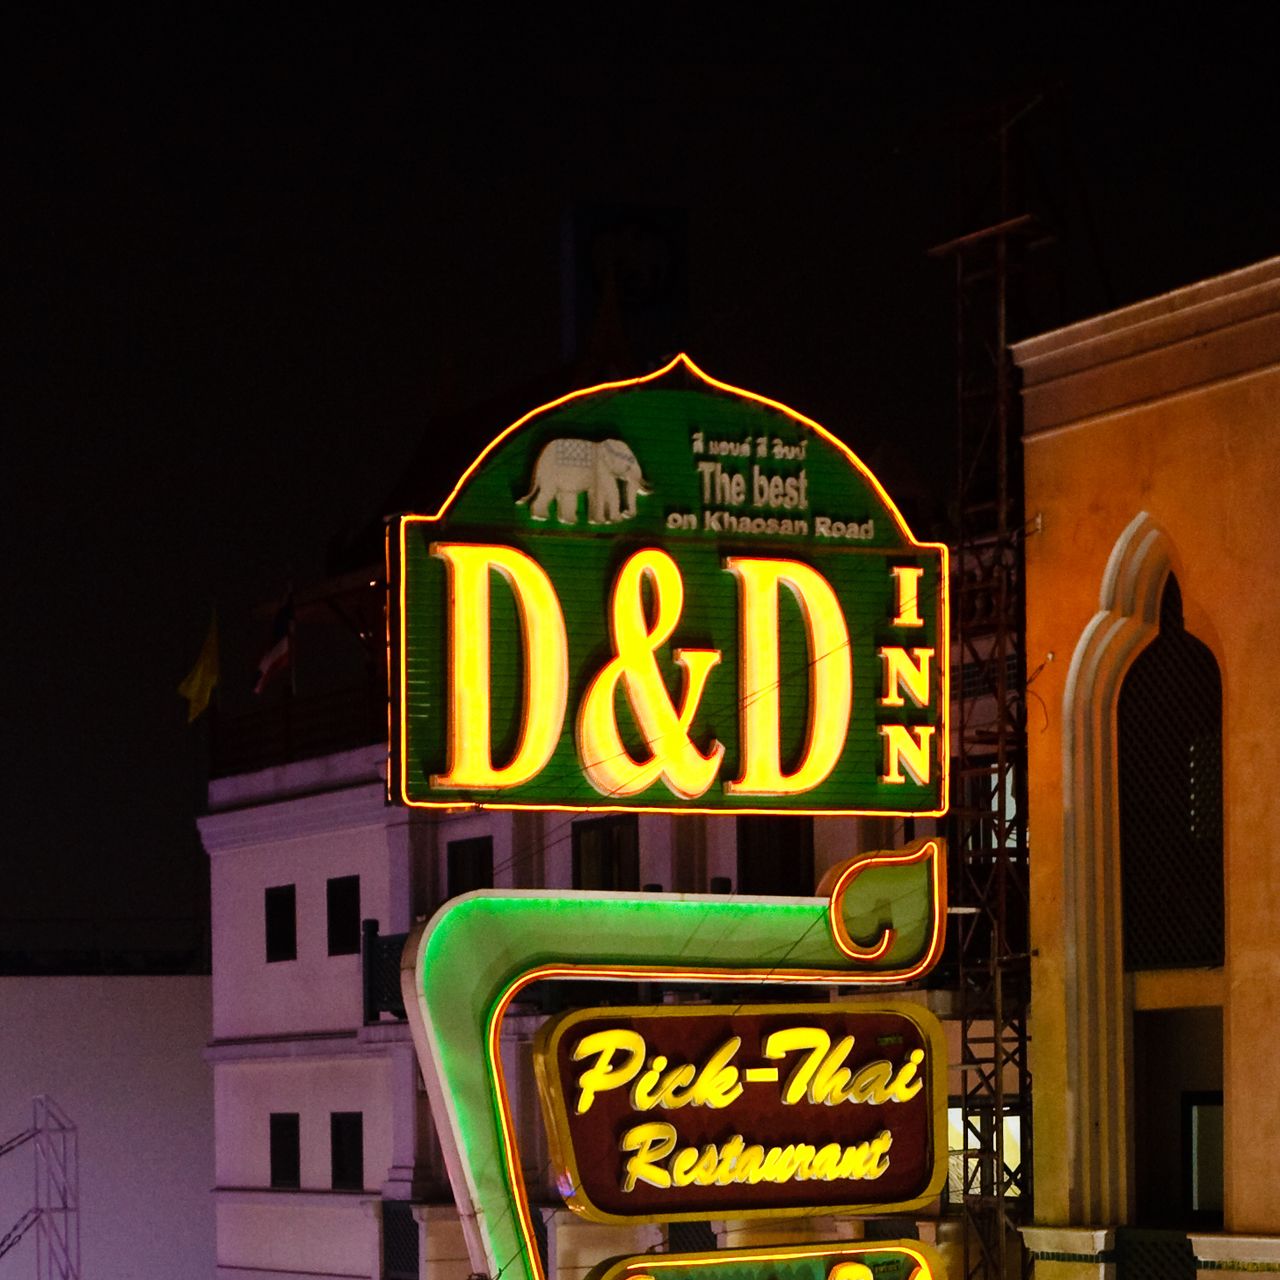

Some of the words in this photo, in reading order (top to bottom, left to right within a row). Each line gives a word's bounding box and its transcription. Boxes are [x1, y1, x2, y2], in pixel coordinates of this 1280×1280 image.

[666, 512, 698, 530] on
[704, 510, 809, 535] Khaosan
[815, 516, 874, 540] Road
[697, 461, 746, 506] The
[753, 464, 808, 509] best
[429, 541, 853, 800] D&D
[877, 565, 936, 786] INN
[570, 1026, 925, 1115] Pick-Thai
[621, 1121, 893, 1193] Restaurant
